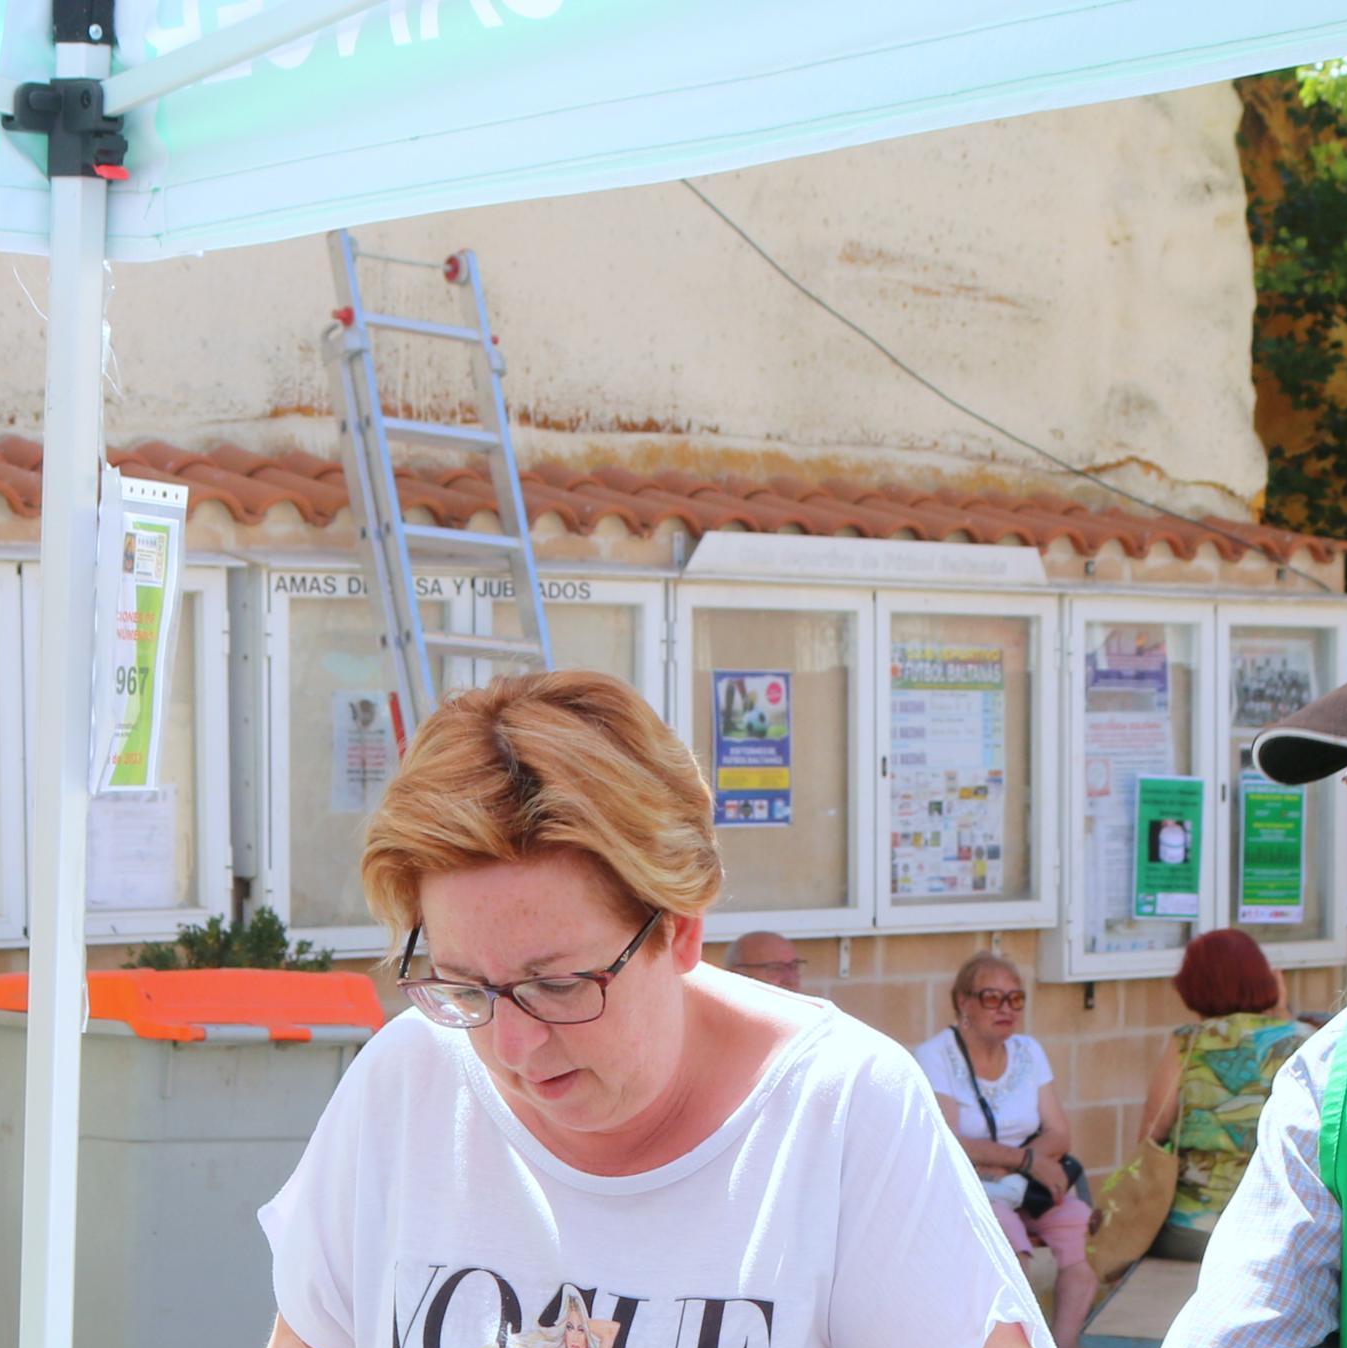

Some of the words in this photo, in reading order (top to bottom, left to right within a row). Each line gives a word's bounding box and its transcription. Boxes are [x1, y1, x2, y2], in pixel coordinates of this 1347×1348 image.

[275, 576, 337, 594] AMAS
[453, 581, 464, 596] Y
[477, 581, 591, 600] JUBADOS
